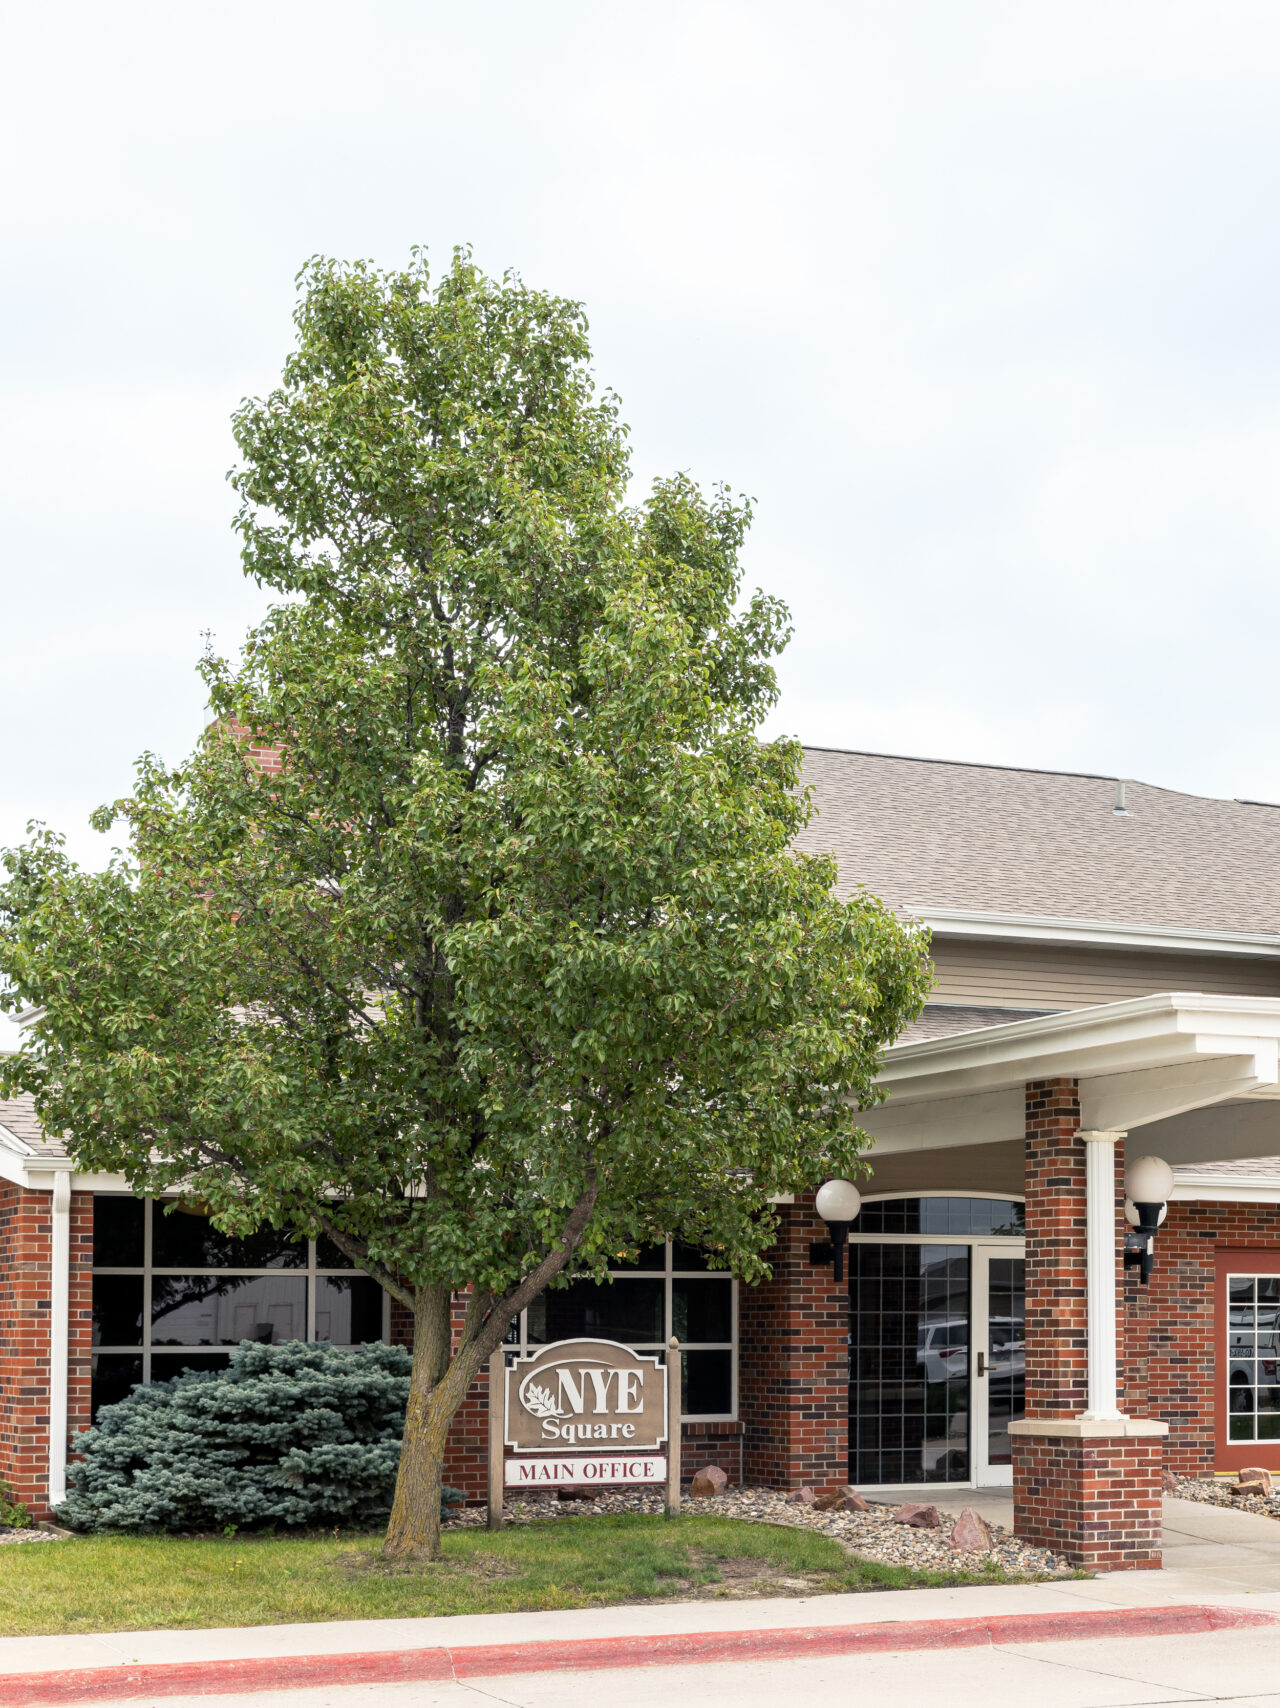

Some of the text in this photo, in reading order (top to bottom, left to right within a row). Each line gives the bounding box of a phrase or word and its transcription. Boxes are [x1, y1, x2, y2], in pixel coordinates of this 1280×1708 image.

[555, 1368, 644, 1414] NYE
[541, 1418, 636, 1444] Square
[519, 1461, 654, 1480] MAIN OFFICE
